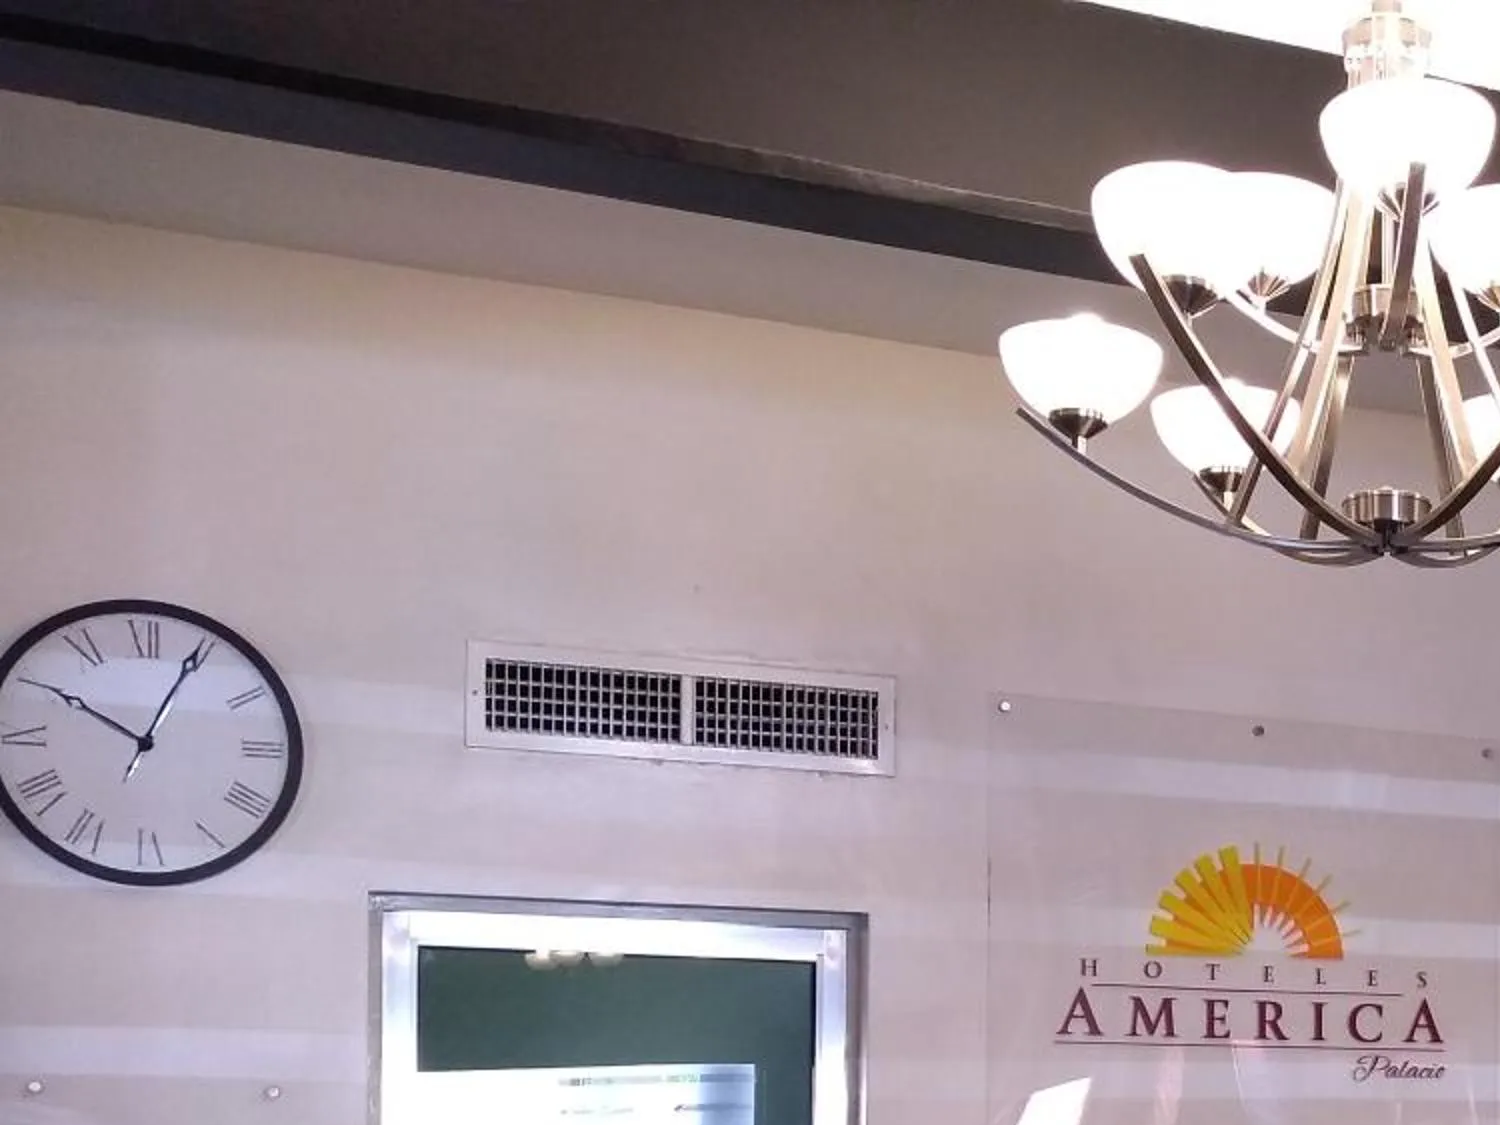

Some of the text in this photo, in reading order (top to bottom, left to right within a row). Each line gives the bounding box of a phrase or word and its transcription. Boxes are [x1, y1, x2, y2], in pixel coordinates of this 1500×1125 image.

[1079, 956, 1429, 990] HOTELES
[1055, 986, 1446, 1045] AMERICA
[1351, 1053, 1447, 1082] Palacio
